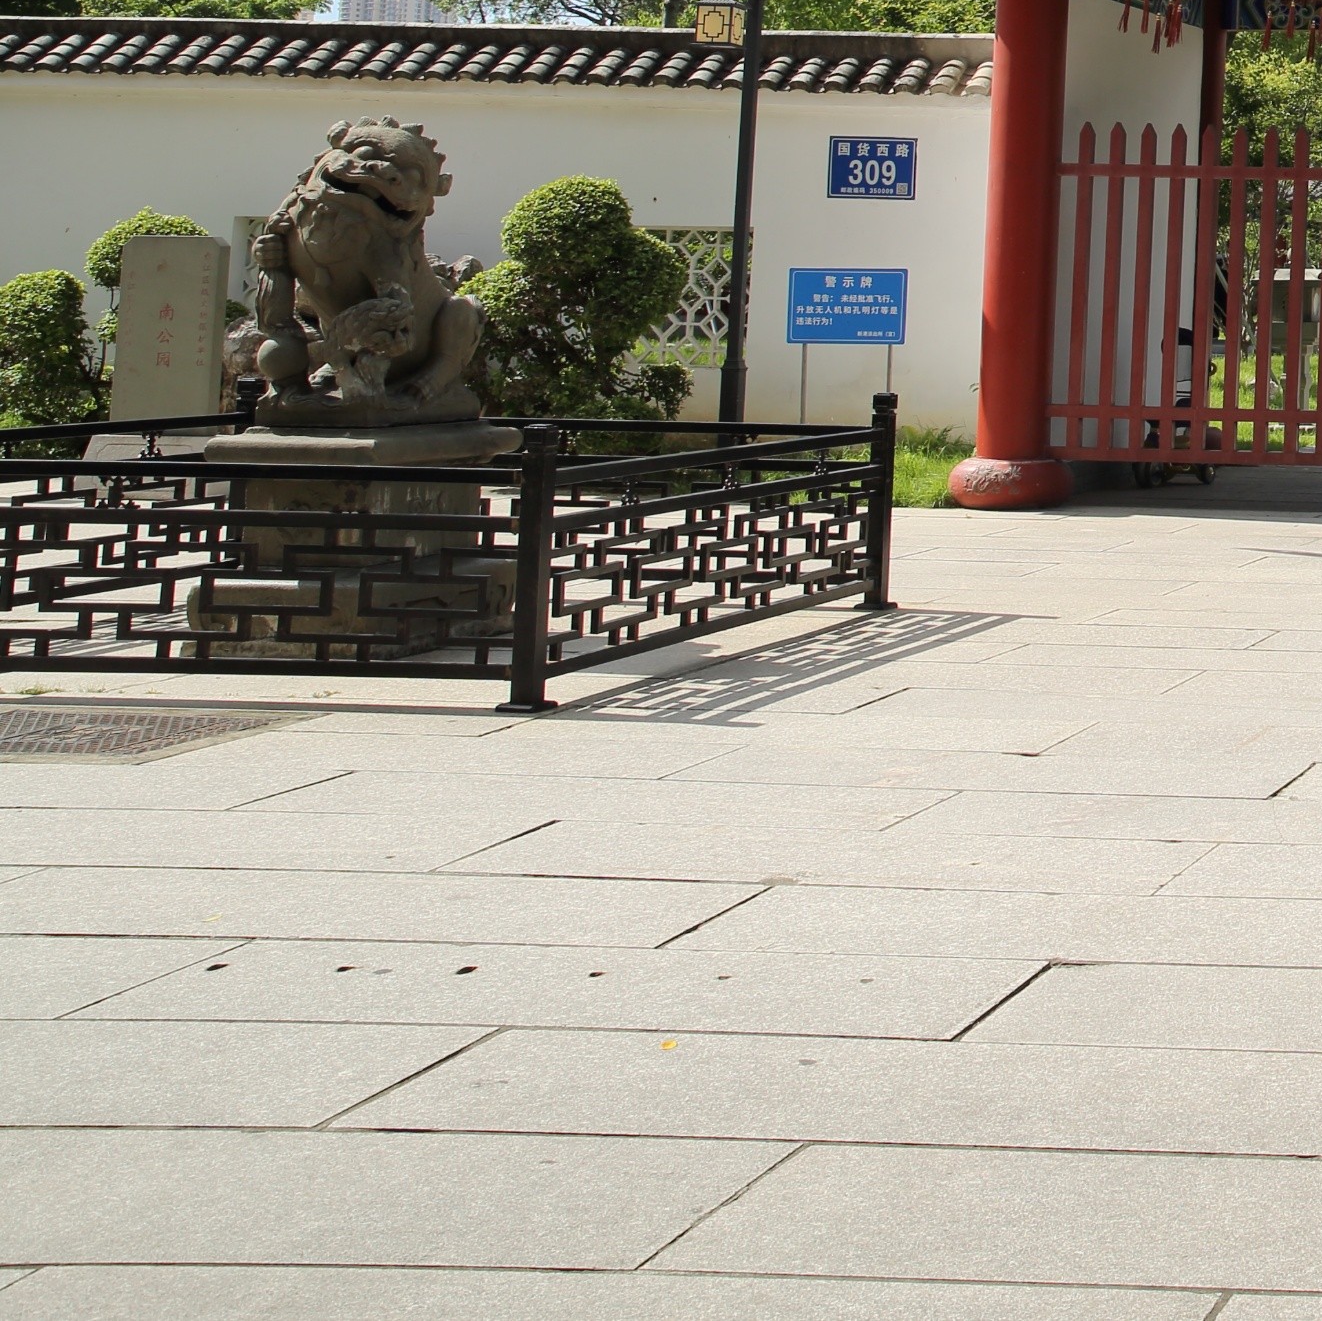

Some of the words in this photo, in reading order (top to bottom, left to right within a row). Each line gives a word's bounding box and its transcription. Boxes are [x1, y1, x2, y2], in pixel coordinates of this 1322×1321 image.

[838, 142, 910, 157] 国货西路
[848, 159, 896, 185] 309
[825, 275, 873, 288] 警示牌
[796, 305, 899, 315] 升放无人机和孔明灯等是
[155, 303, 174, 368] 南公园
